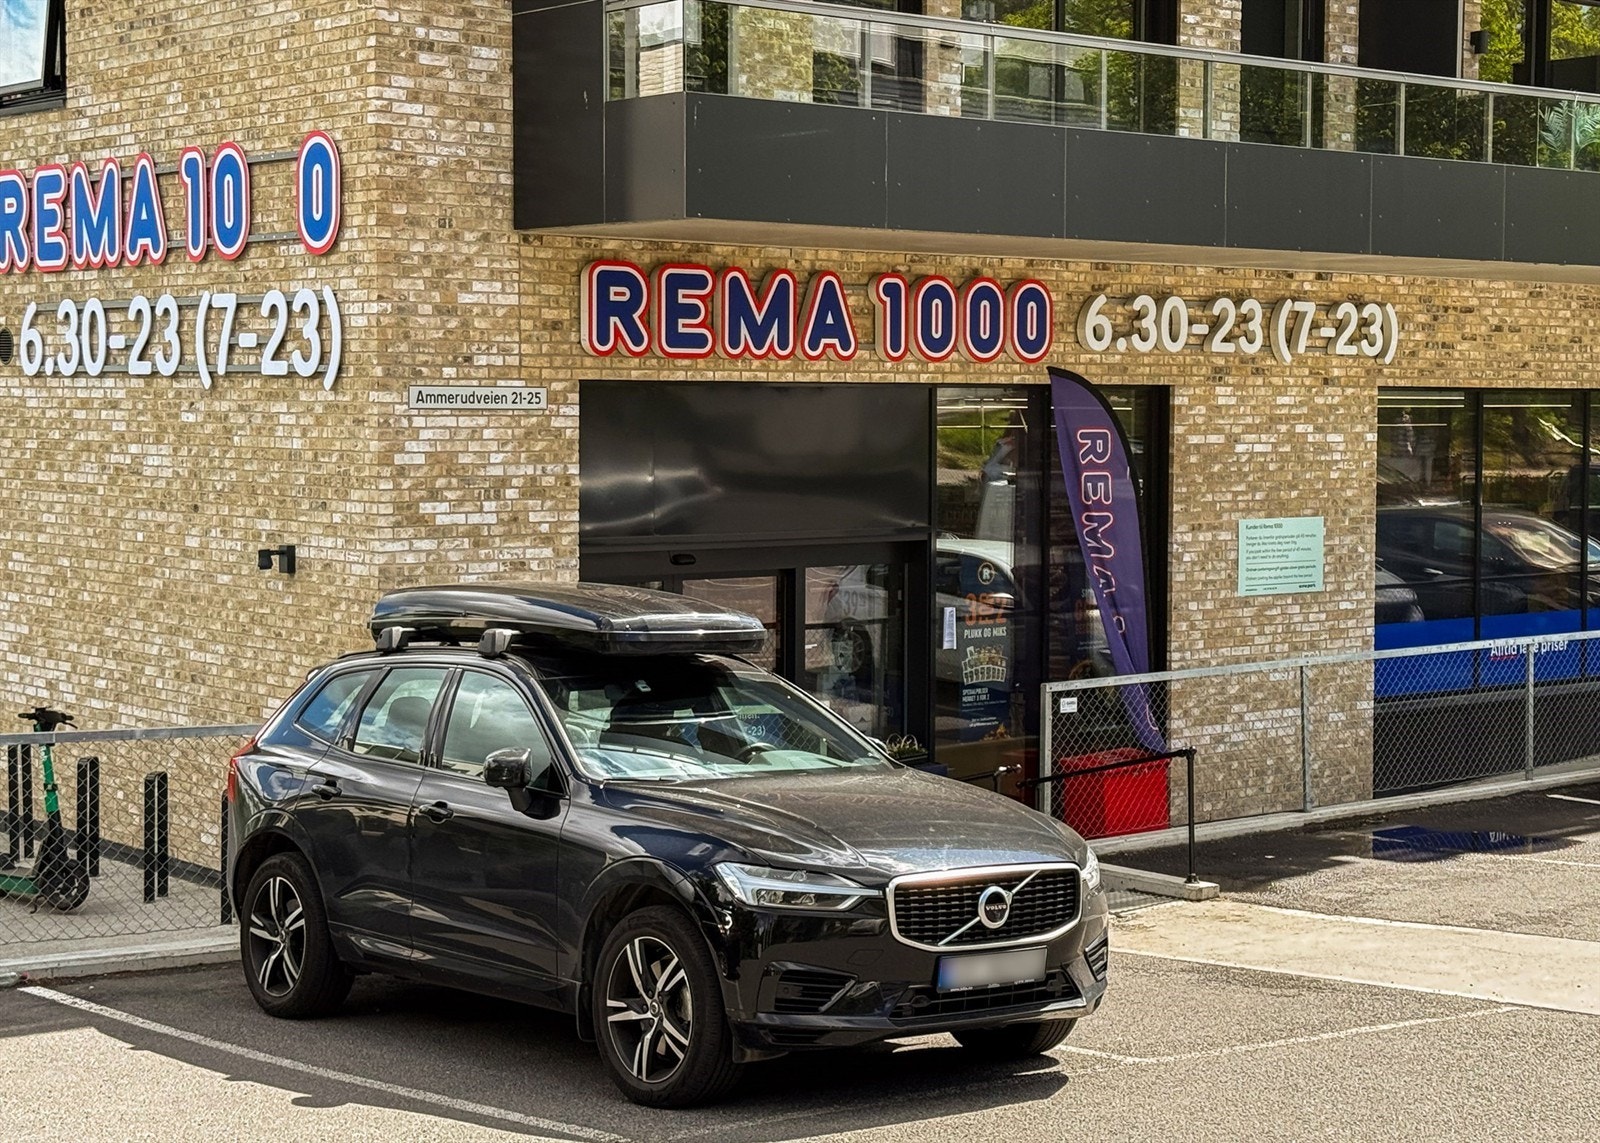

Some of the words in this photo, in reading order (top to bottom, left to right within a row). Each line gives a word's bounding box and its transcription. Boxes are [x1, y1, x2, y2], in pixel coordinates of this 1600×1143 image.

[0, 152, 167, 273] REMA
[20, 294, 181, 377] 6.30-23
[196, 285, 342, 391] (7-23)
[583, 260, 858, 360] REMA
[870, 272, 1053, 363] 1000
[1080, 294, 1263, 353] 6.30-23
[1273, 299, 1399, 364] (7-23)
[416, 390, 508, 405] Ammerudveien
[511, 391, 542, 405] 21-25
[964, 628, 982, 640] PLUKK
[983, 627, 992, 638] OG
[992, 626, 1007, 637] MIKS
[1520, 643, 1538, 654] lae
[1541, 640, 1568, 654] priser
